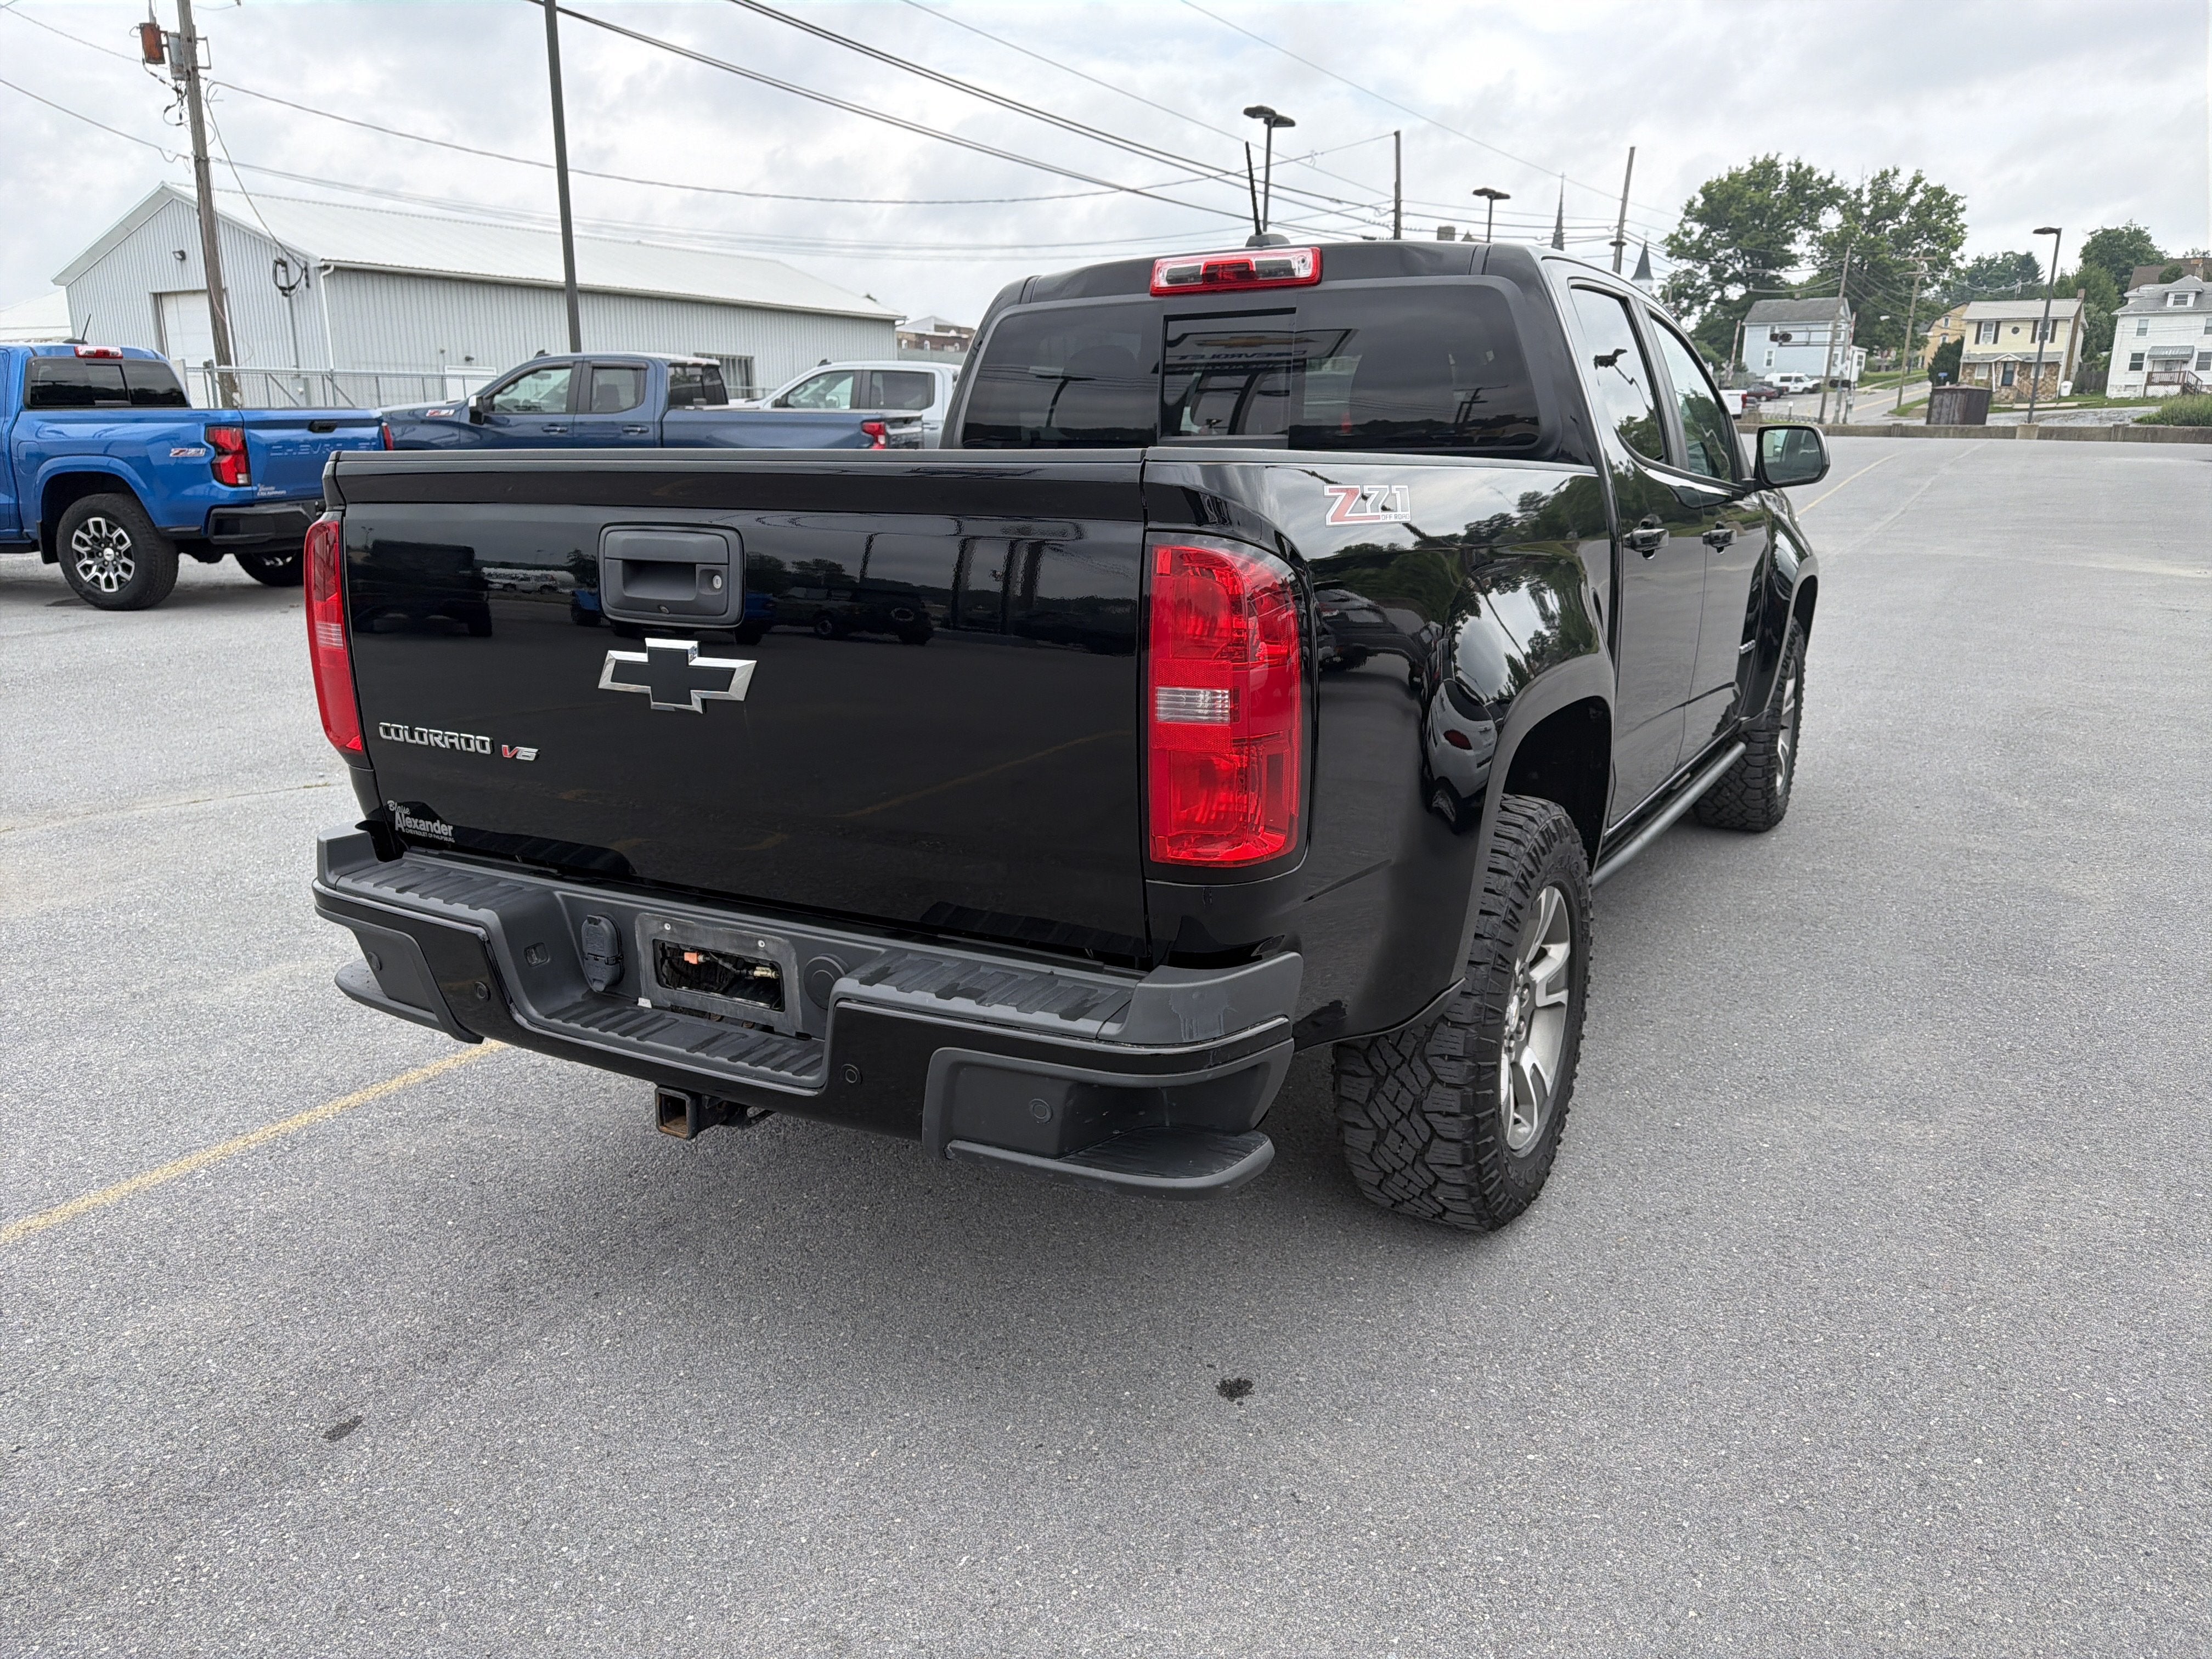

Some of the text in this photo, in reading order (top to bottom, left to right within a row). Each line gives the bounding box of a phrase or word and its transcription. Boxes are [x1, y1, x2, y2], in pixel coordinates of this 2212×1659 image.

[169, 448, 207, 458] Z71
[269, 442, 377, 456] CHEVRET
[1324, 485, 1410, 526] Z71
[379, 722, 541, 761] COLORADO V6
[387, 800, 411, 815] Blaise
[395, 812, 453, 837] Alexander
